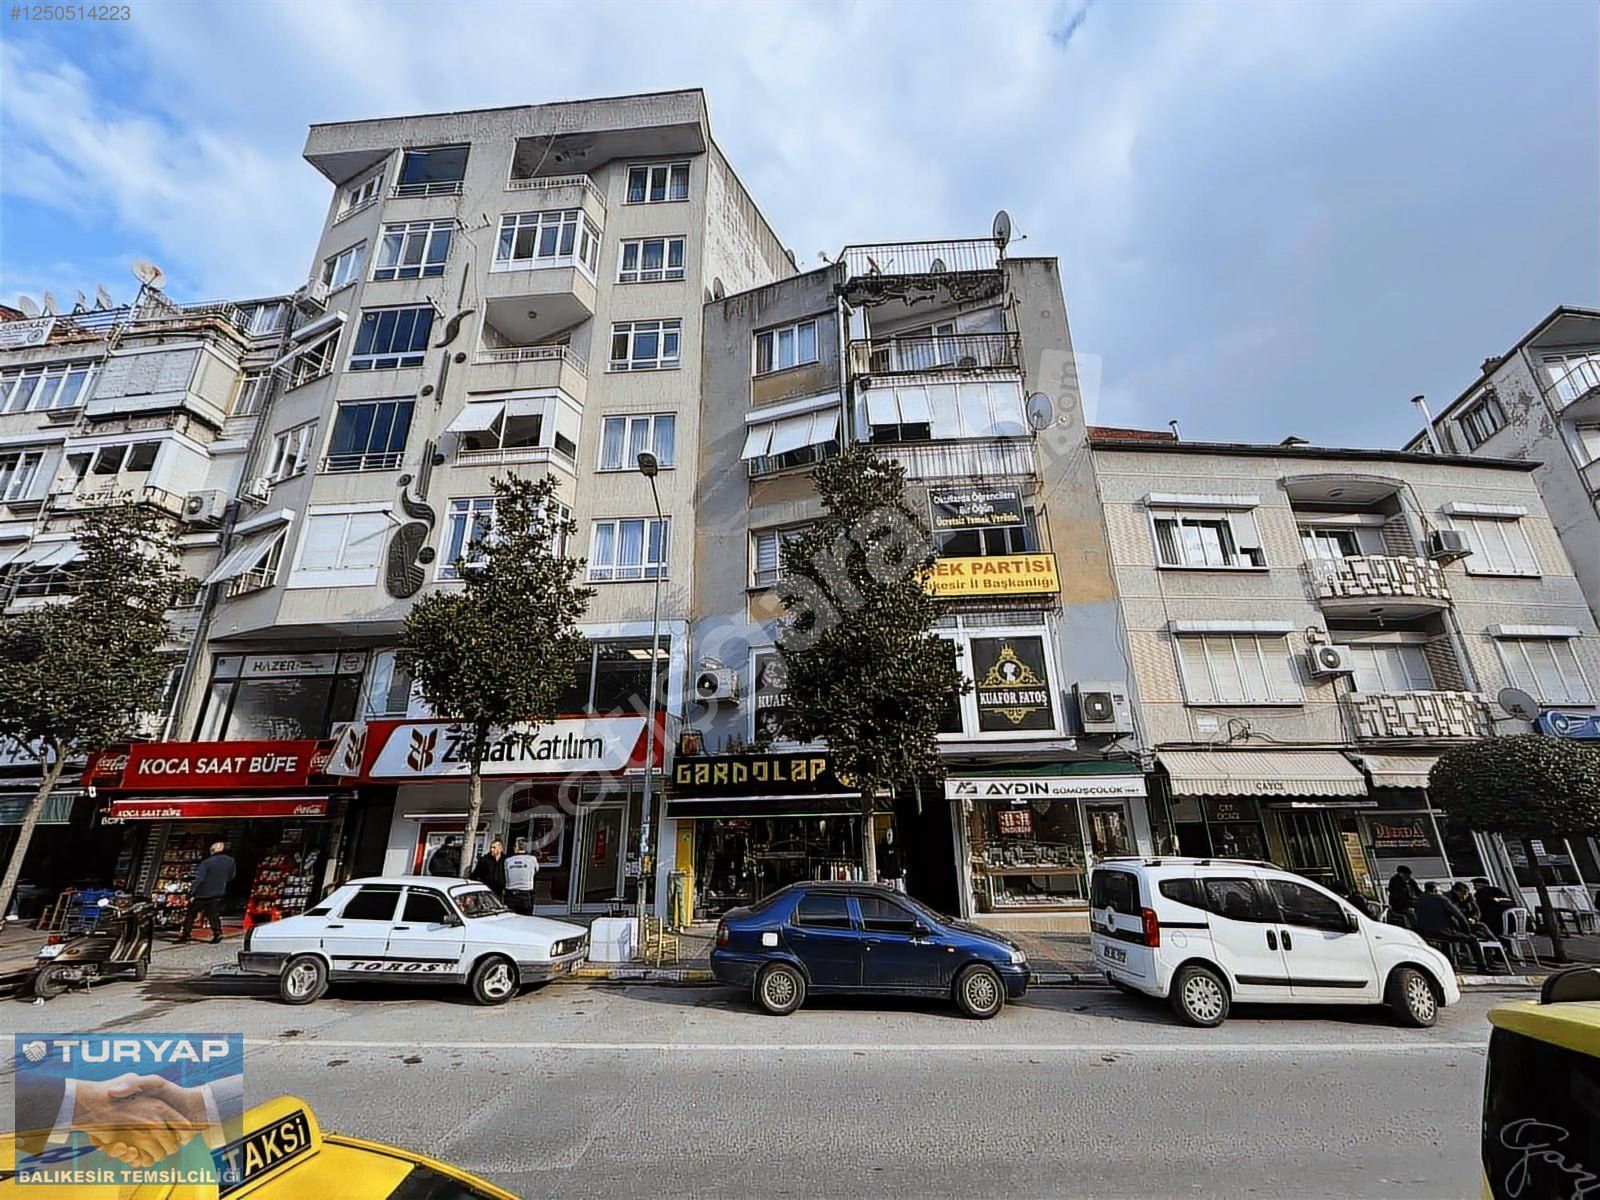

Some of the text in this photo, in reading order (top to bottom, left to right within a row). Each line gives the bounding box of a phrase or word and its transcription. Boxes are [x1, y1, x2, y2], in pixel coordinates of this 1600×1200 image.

[971, 557, 1051, 574] PARTİSİ
[983, 576, 1054, 590] Başkanlığı
[979, 689, 1048, 706] KUAFÖR FATOŞ
[519, 732, 603, 761] Katılım
[138, 758, 190, 775] KOCA
[195, 757, 245, 774] SAAT
[249, 753, 298, 773] BÜFE
[986, 782, 1049, 795] AYDIN
[347, 961, 441, 973] TOROS
[221, 1117, 308, 1176] TAKSİ
